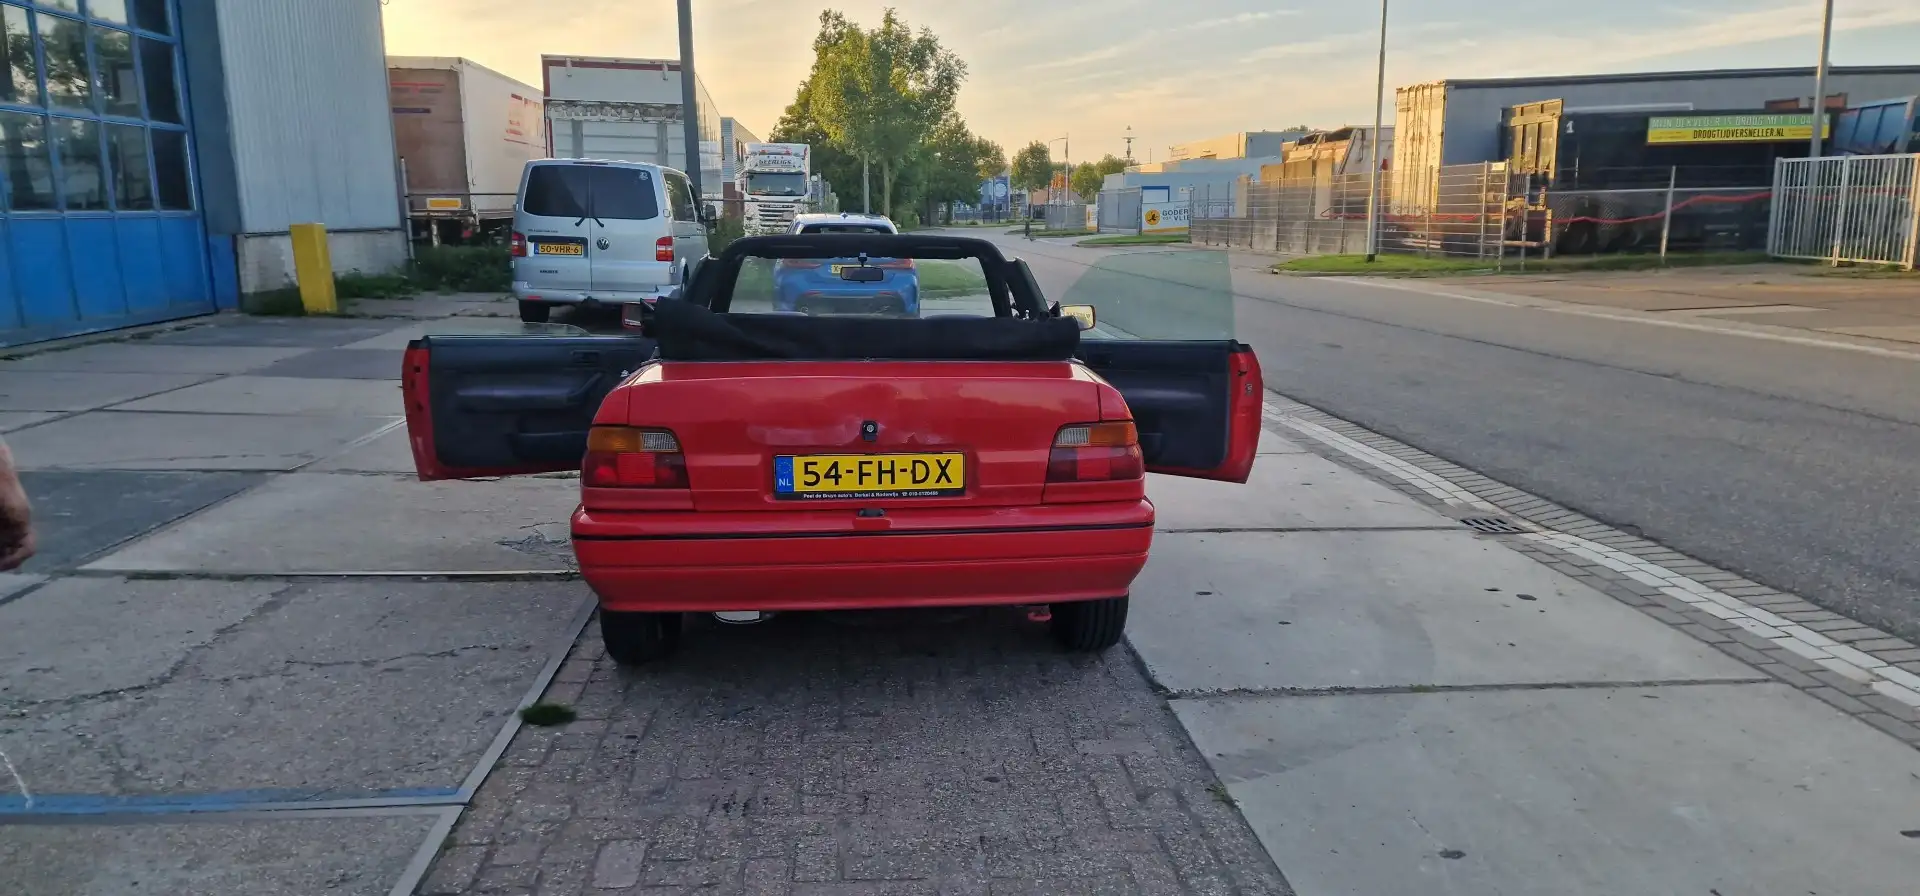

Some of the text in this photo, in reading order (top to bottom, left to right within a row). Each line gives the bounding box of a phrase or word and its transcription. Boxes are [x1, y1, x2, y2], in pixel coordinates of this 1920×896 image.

[1566, 121, 1575, 133] 1
[1693, 127, 1785, 139] DROOGTIJDVERSNELLER.NL
[540, 245, 579, 254] 50-VHR-6
[803, 458, 953, 487] 54-FH-DX
[778, 478, 792, 487] NL
